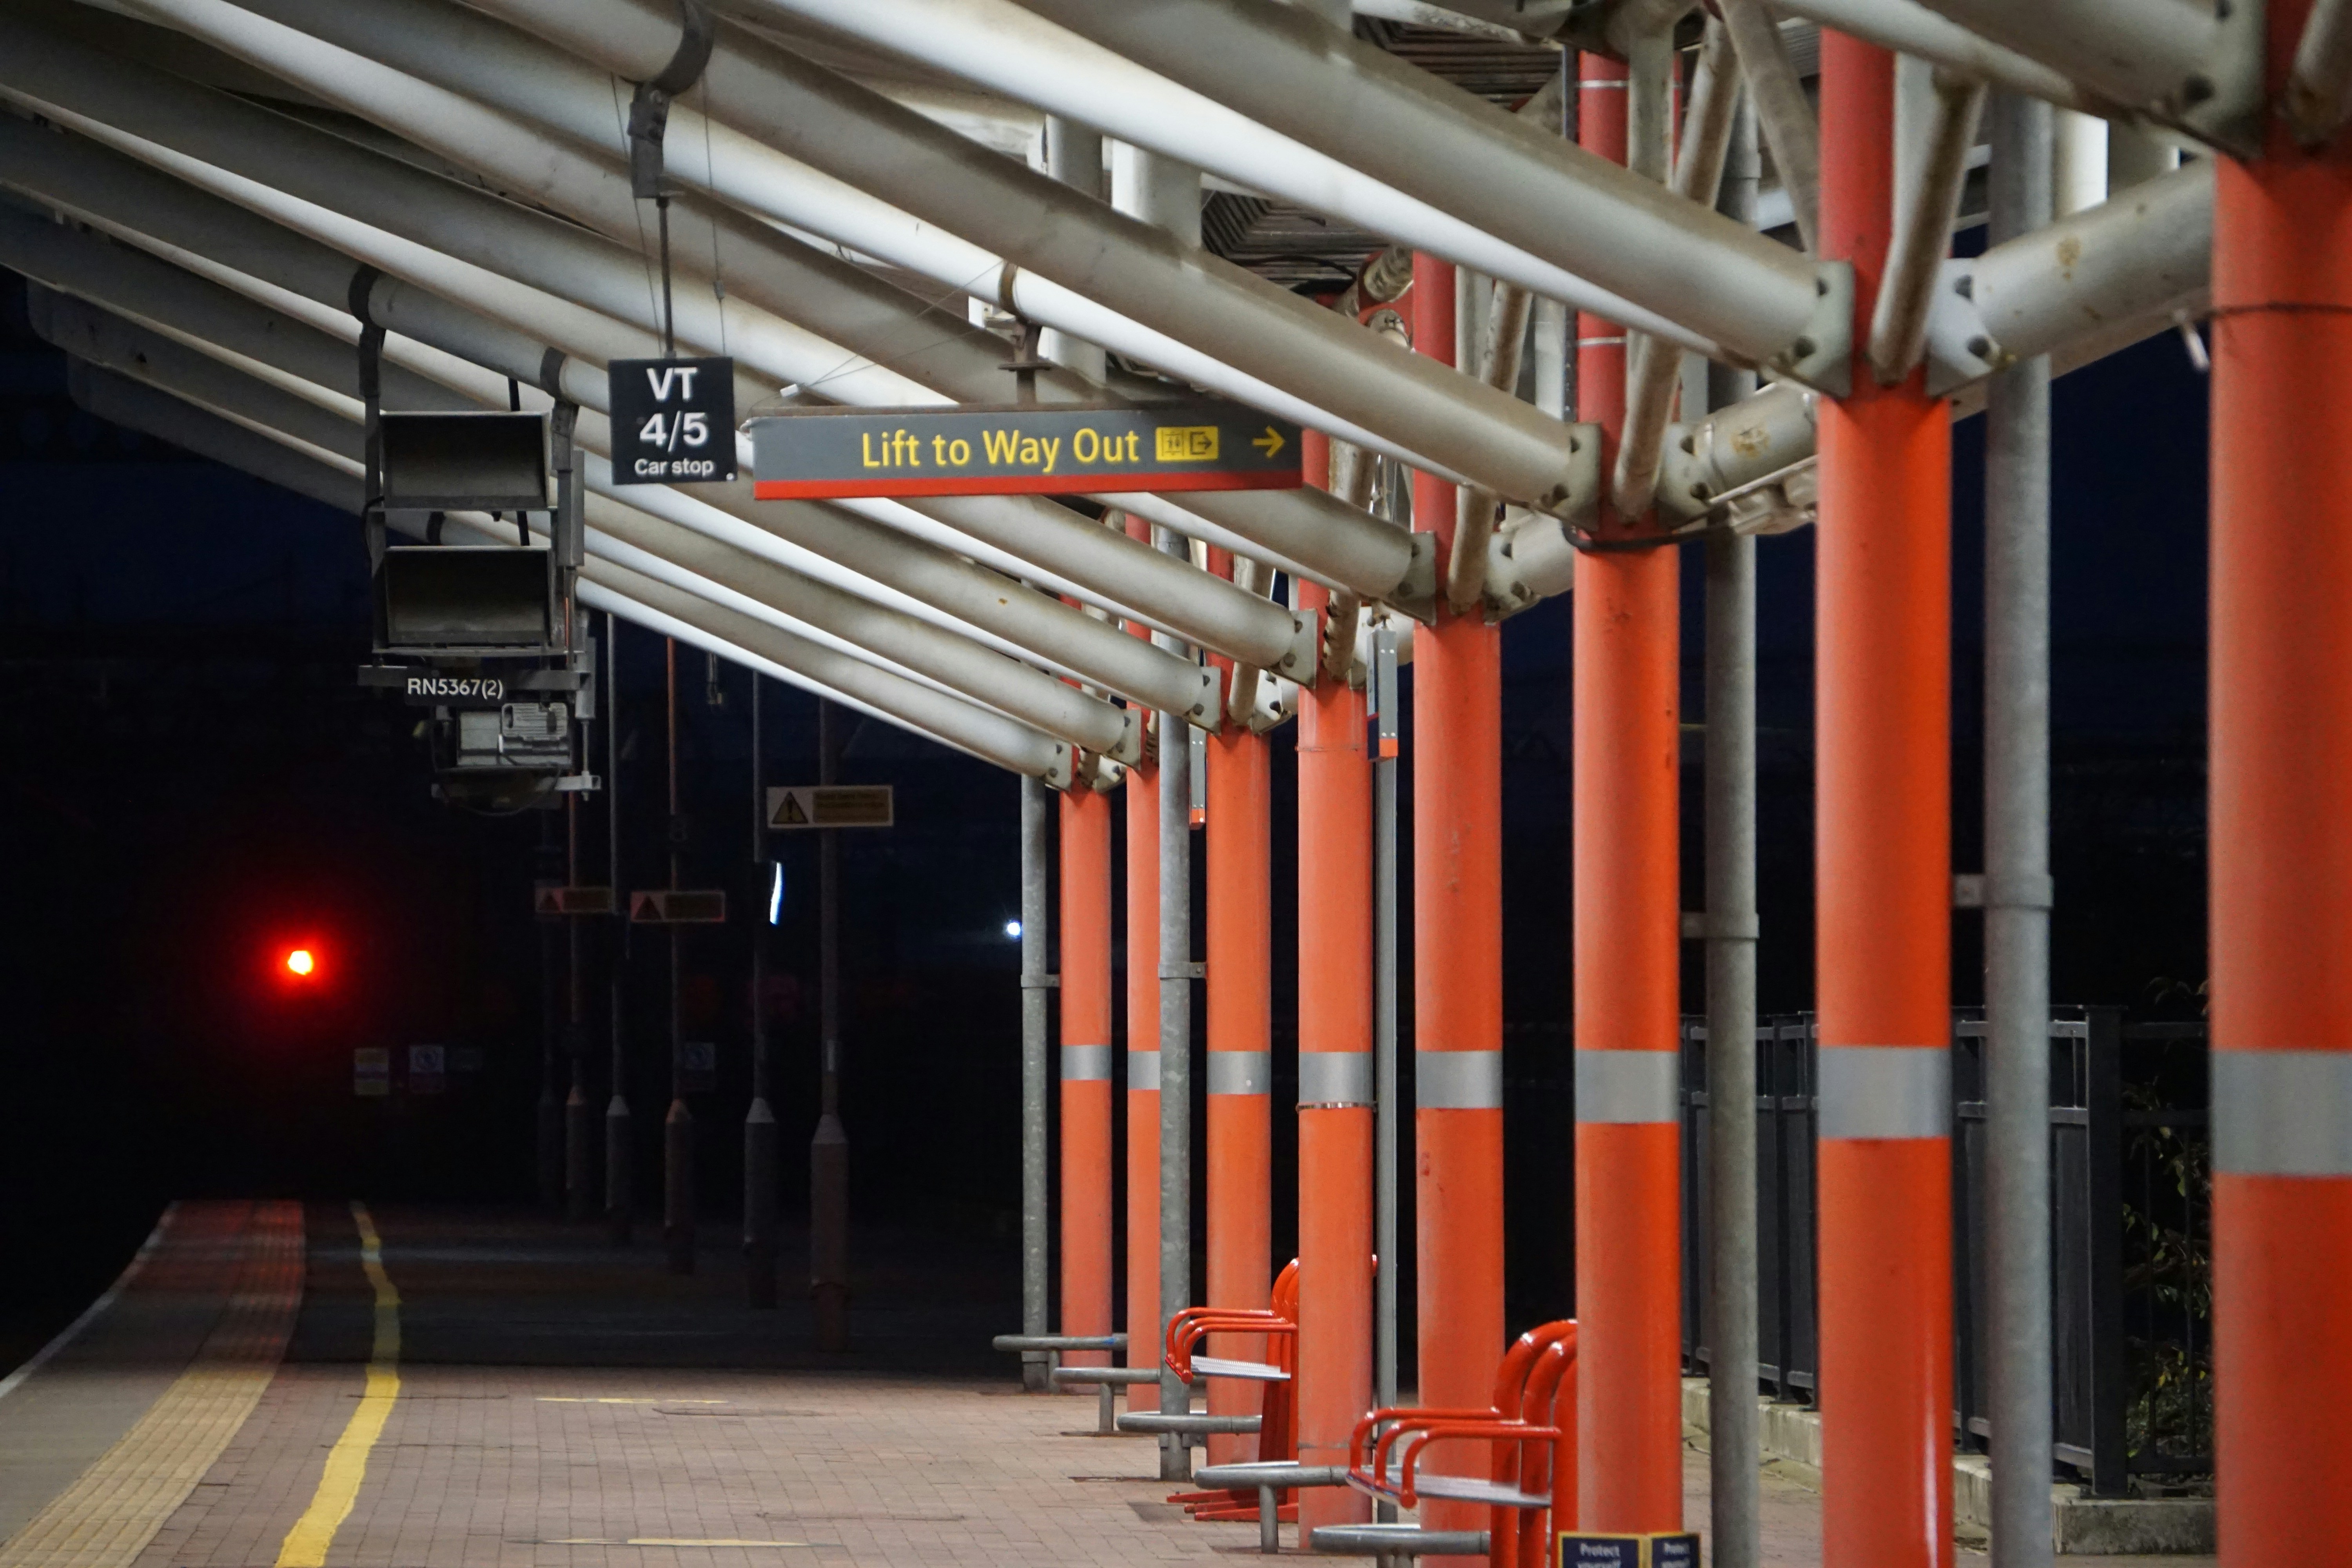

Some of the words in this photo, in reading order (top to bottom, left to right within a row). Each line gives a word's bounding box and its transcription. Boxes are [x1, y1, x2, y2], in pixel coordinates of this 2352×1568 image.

[646, 367, 698, 402] VT
[639, 410, 708, 455] 4/5
[634, 458, 667, 477] Car
[671, 457, 716, 478] stop
[862, 430, 920, 467] Lift
[931, 434, 971, 466] to
[982, 430, 1060, 473] Way
[1073, 428, 1140, 463] Out
[407, 677, 504, 700] RN5367(2)
